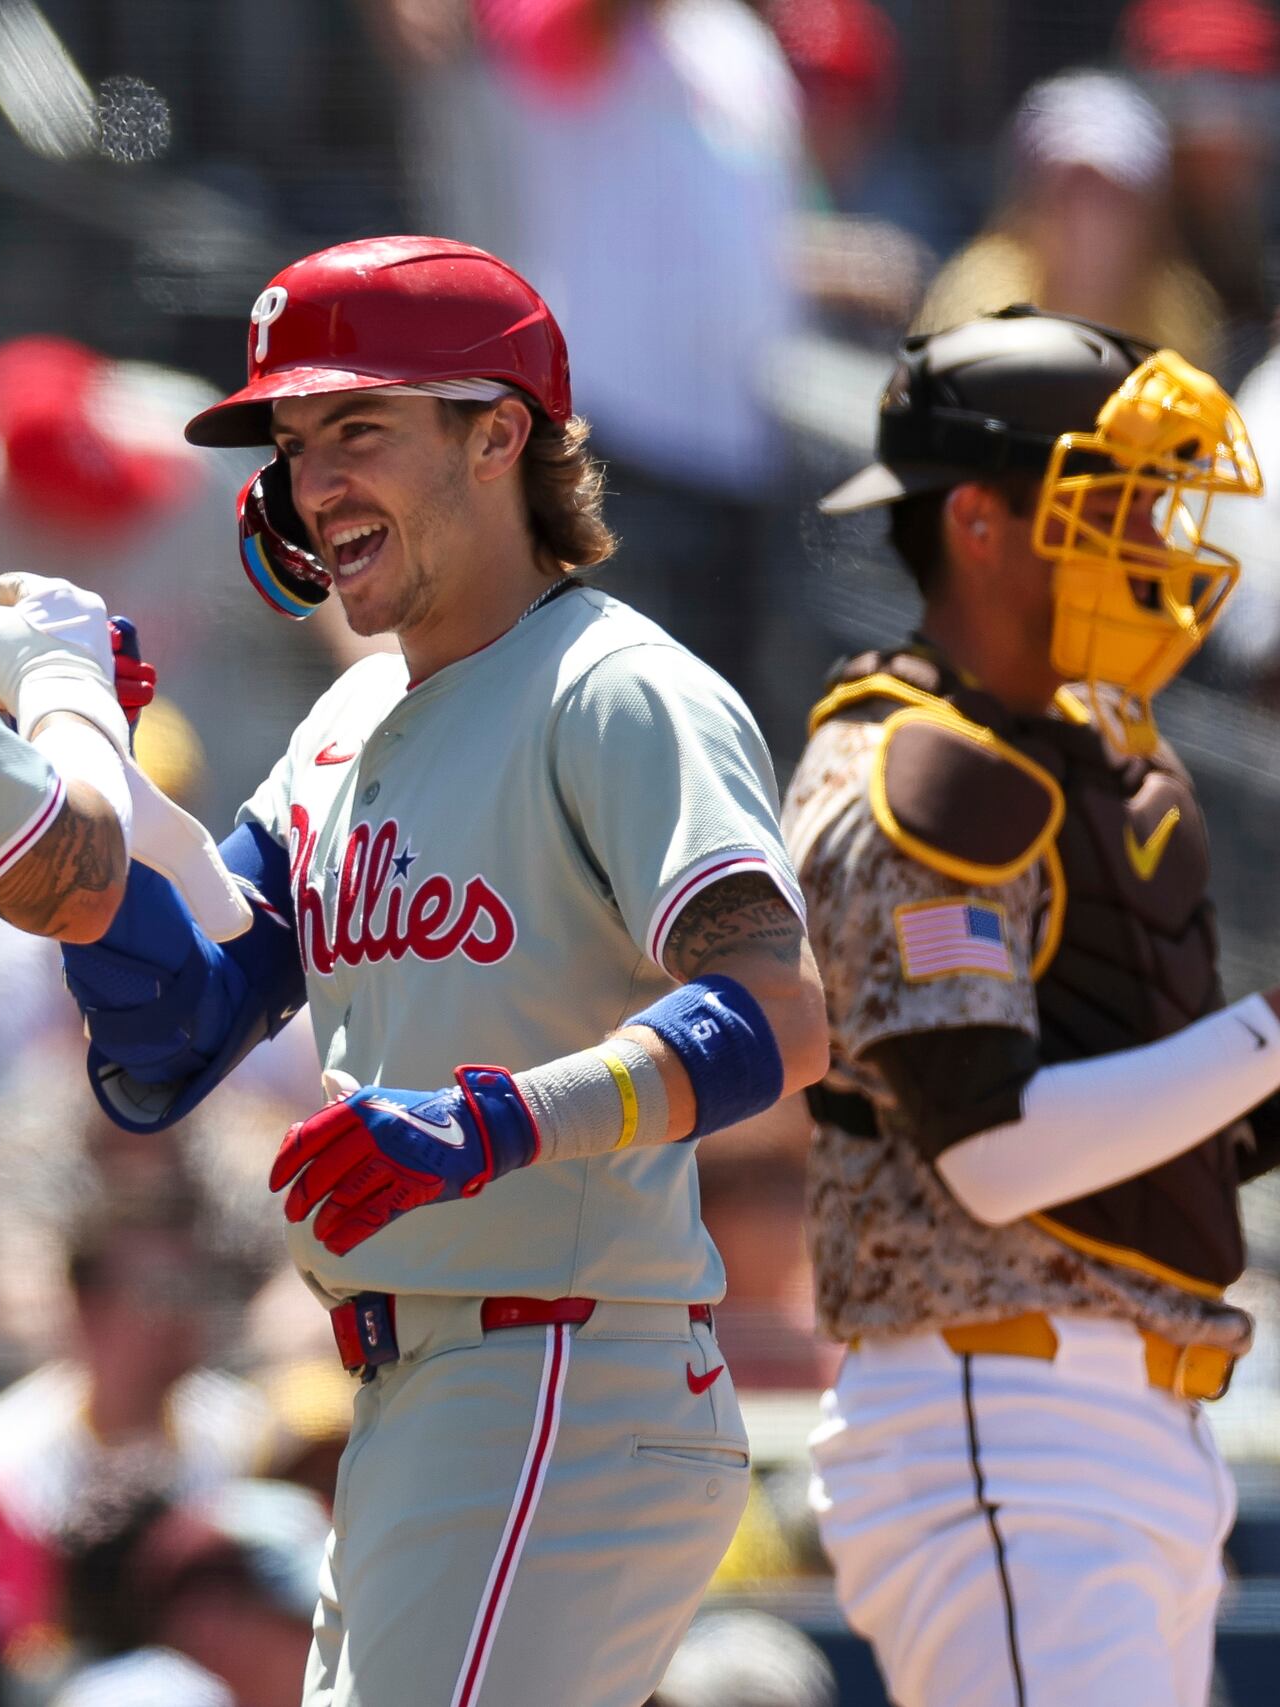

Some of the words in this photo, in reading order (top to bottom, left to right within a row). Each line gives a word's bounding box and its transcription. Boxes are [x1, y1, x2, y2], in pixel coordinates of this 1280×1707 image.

[251, 285, 288, 364] P
[290, 804, 516, 976] hllies
[738, 901, 790, 925] VEG
[691, 1018, 720, 1041] 5
